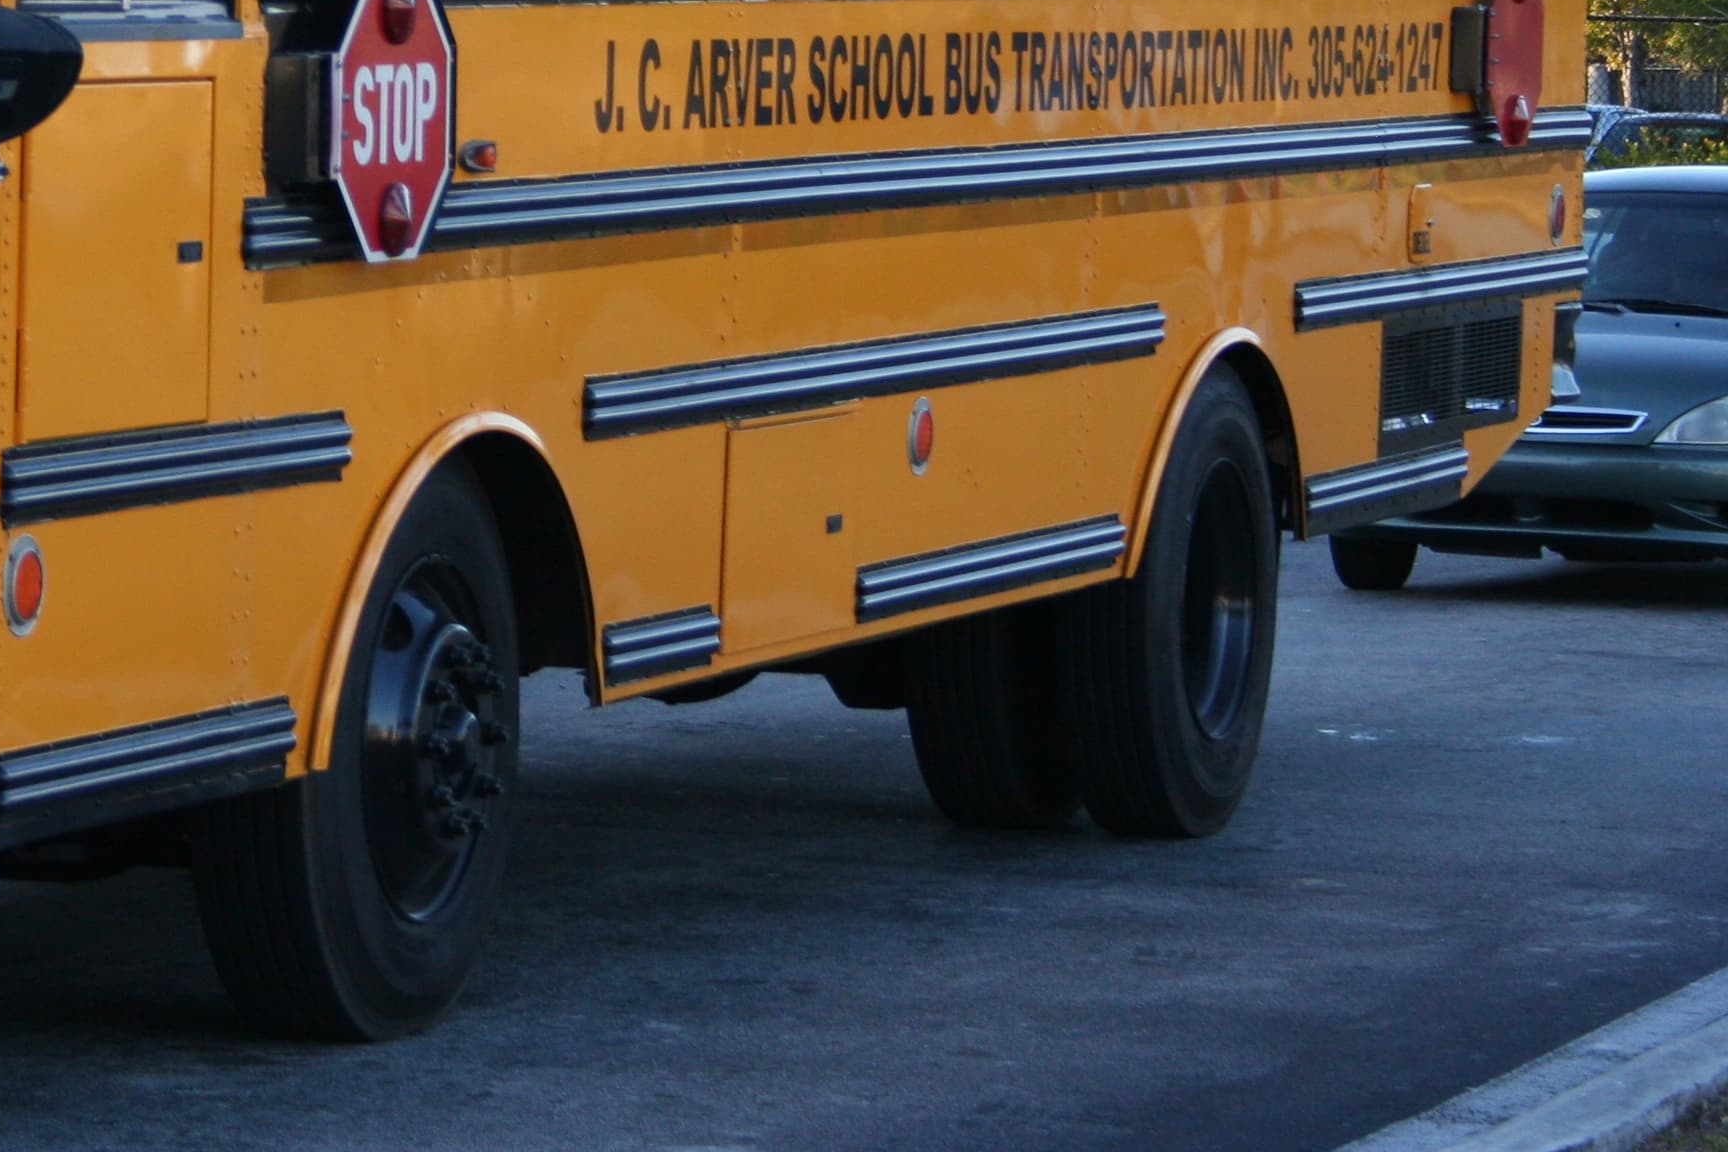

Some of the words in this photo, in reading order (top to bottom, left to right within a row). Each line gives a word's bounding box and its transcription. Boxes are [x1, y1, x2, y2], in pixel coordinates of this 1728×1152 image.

[352, 61, 437, 166] STOP
[683, 38, 797, 129] ARVER
[806, 32, 934, 124] SCHOOL
[944, 30, 1001, 115] BUS
[1012, 29, 1246, 112] TRANSPORTATION
[1253, 26, 1299, 102] INC.
[1308, 22, 1444, 99] 305-624-1247
